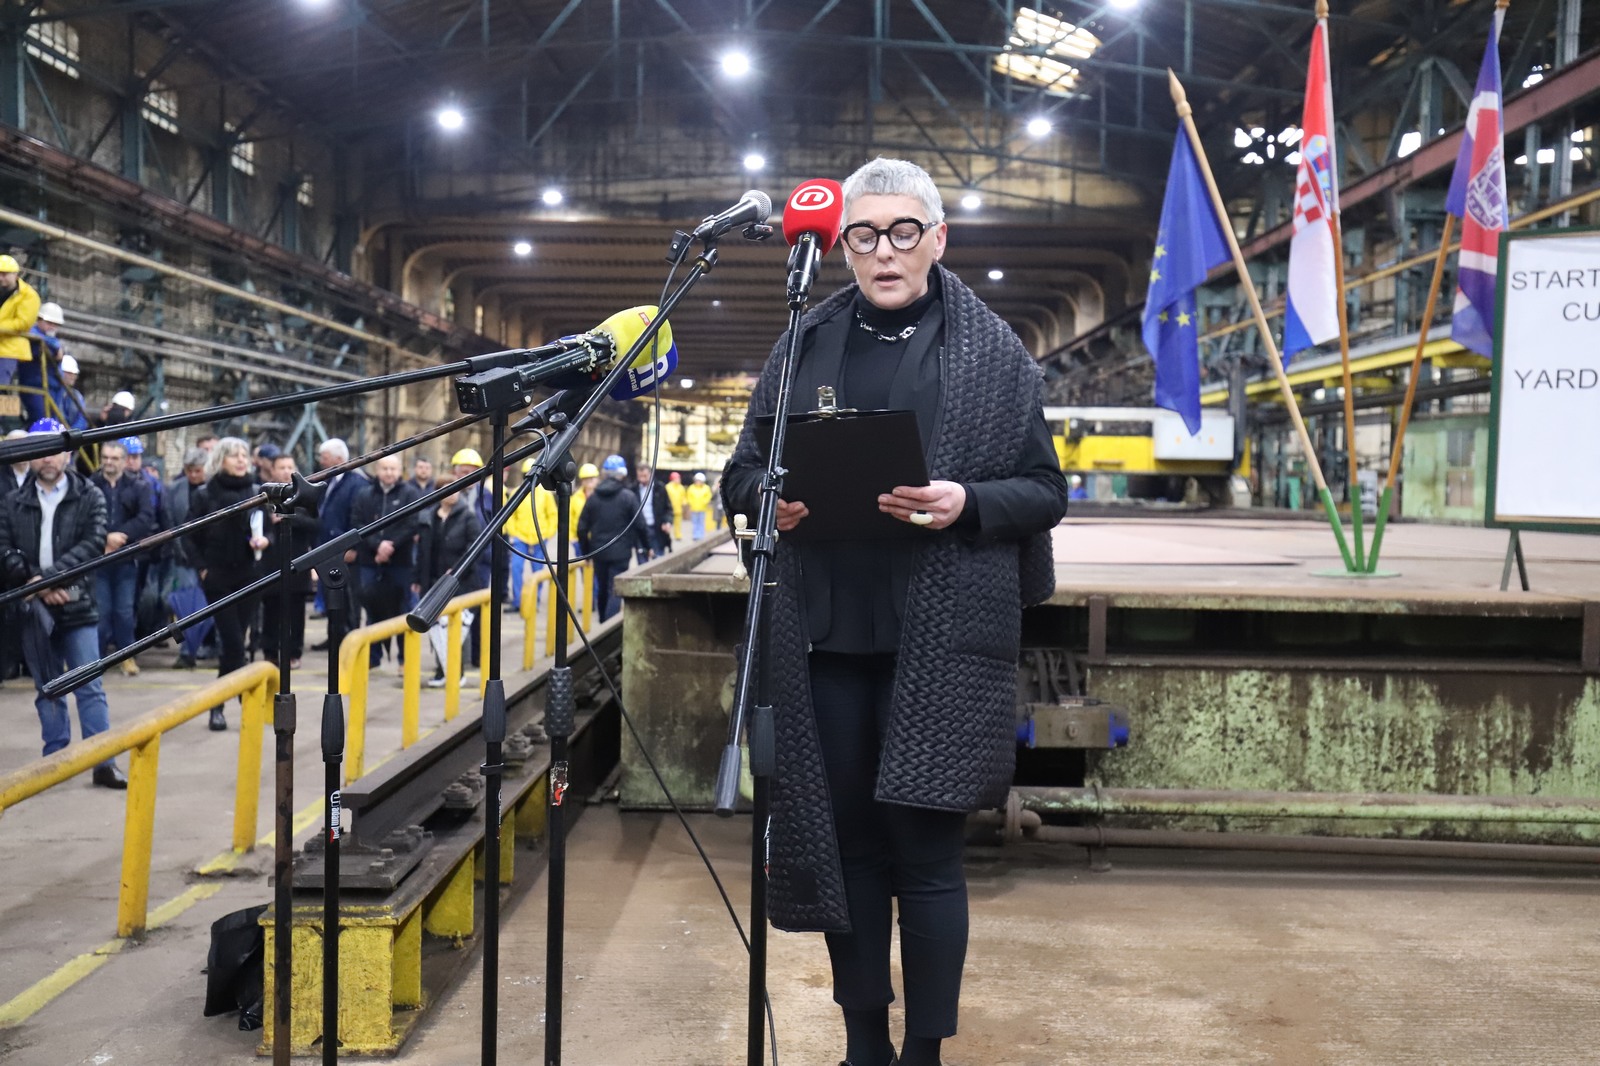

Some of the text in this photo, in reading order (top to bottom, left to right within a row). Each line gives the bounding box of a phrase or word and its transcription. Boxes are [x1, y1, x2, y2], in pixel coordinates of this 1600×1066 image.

[1511, 269, 1600, 291] START
[1562, 302, 1600, 322] CU
[1514, 368, 1599, 390] YARD
